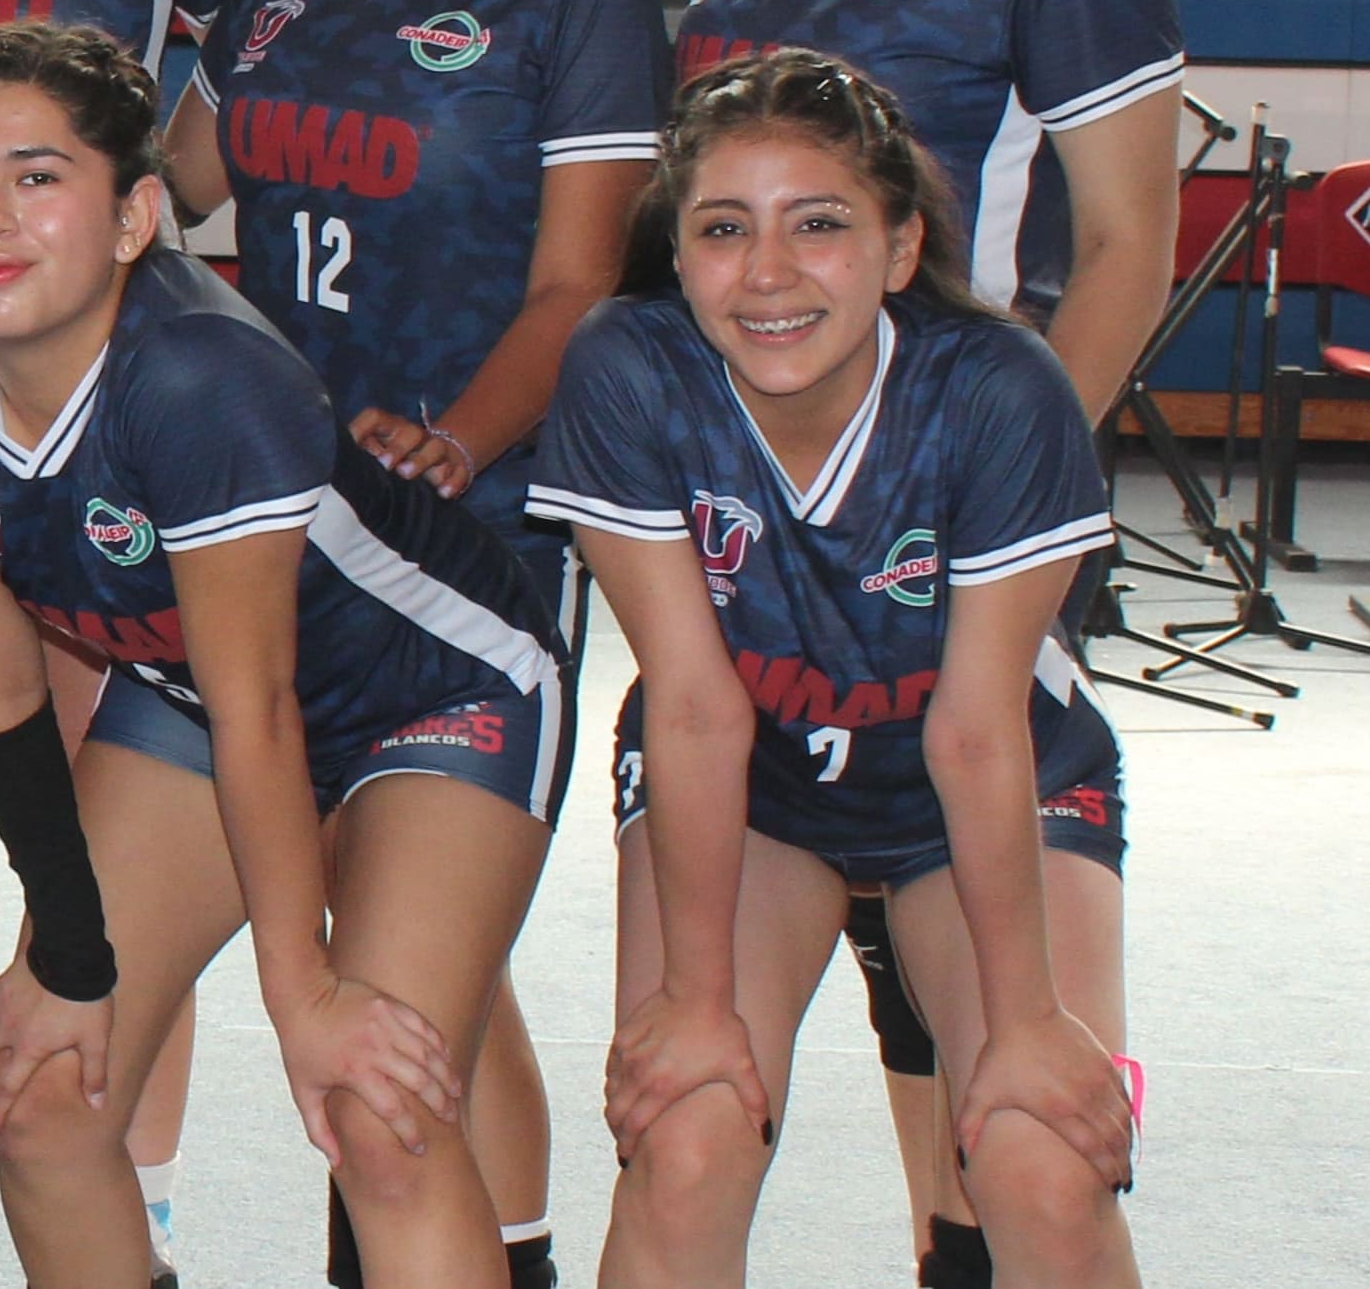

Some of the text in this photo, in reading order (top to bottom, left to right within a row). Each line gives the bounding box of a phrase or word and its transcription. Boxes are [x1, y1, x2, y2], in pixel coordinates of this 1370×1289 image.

[398, 26, 472, 49] CONADEIP
[229, 96, 421, 200] UMAD
[293, 210, 353, 313] 12
[807, 726, 851, 781] 7
